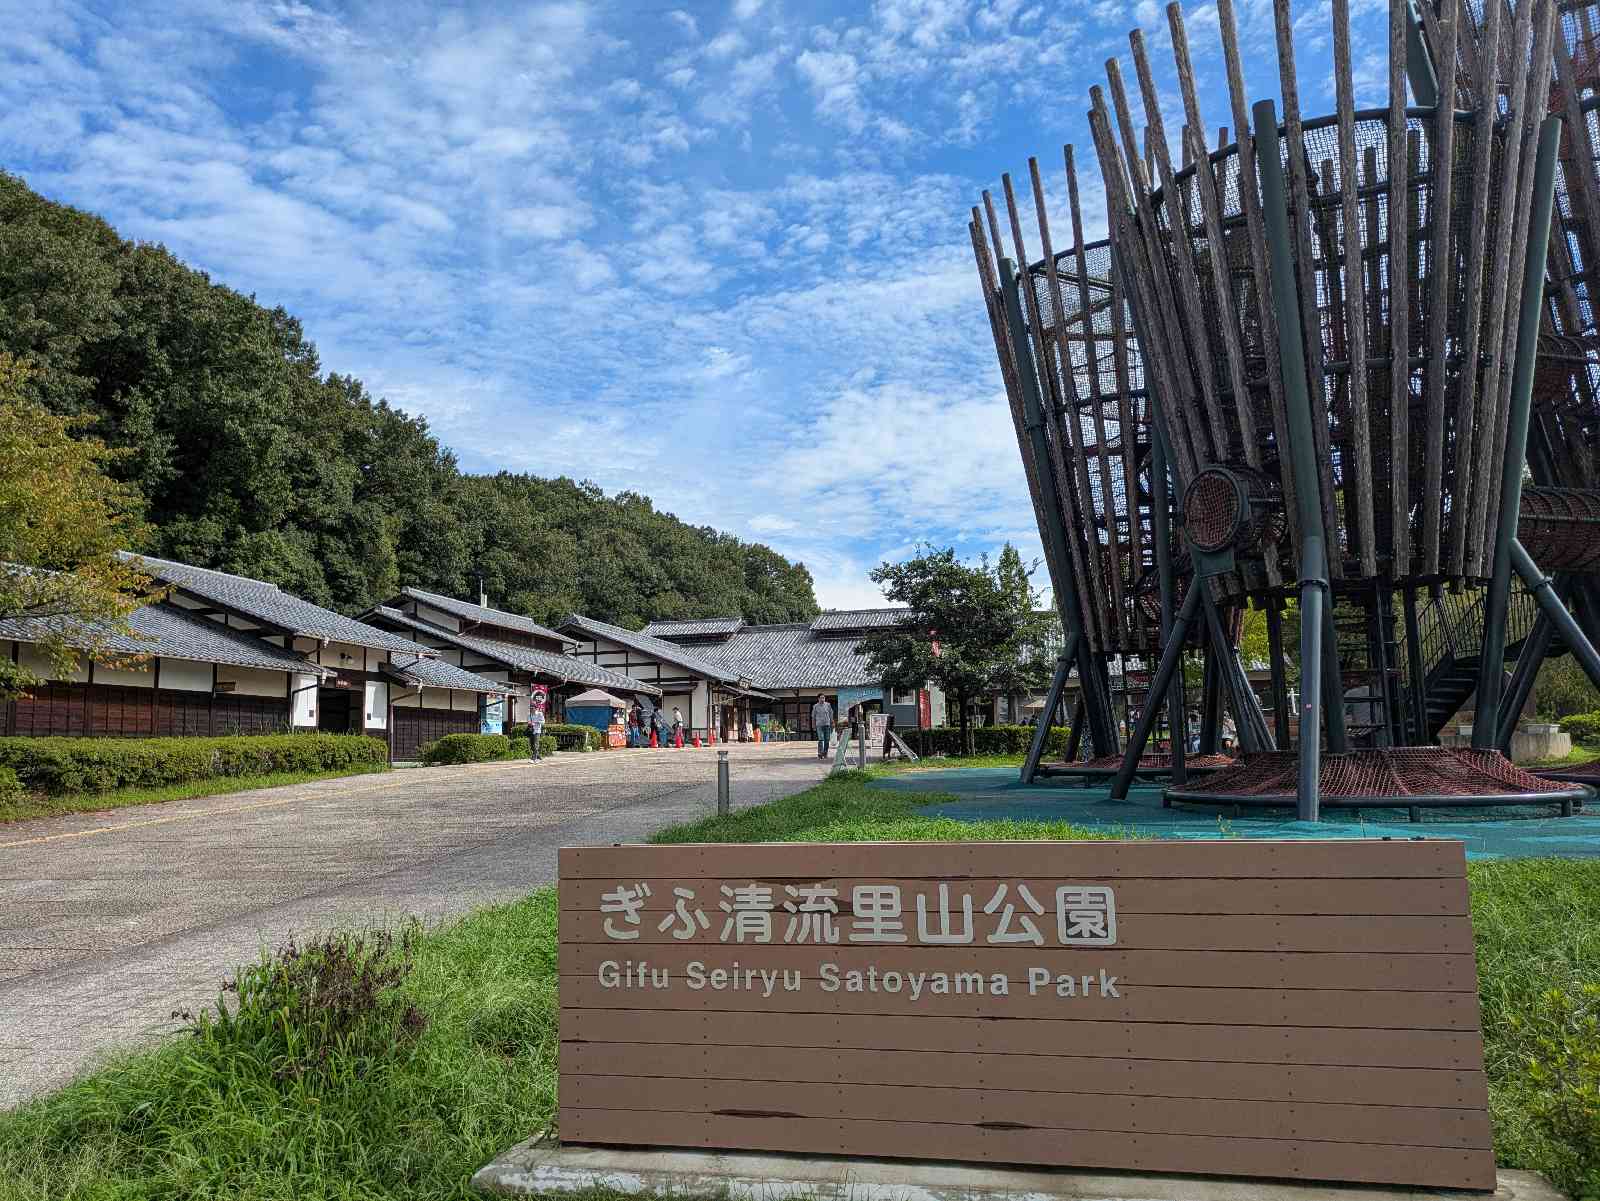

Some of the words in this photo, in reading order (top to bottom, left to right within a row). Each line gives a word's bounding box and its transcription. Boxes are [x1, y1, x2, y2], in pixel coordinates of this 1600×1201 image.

[600, 883, 1116, 945] ぎふ清流里山公園
[598, 960, 669, 990] Gifu
[687, 962, 801, 997] Seiryu
[820, 963, 1009, 1000] Satoyama
[1029, 967, 1120, 998] Park
